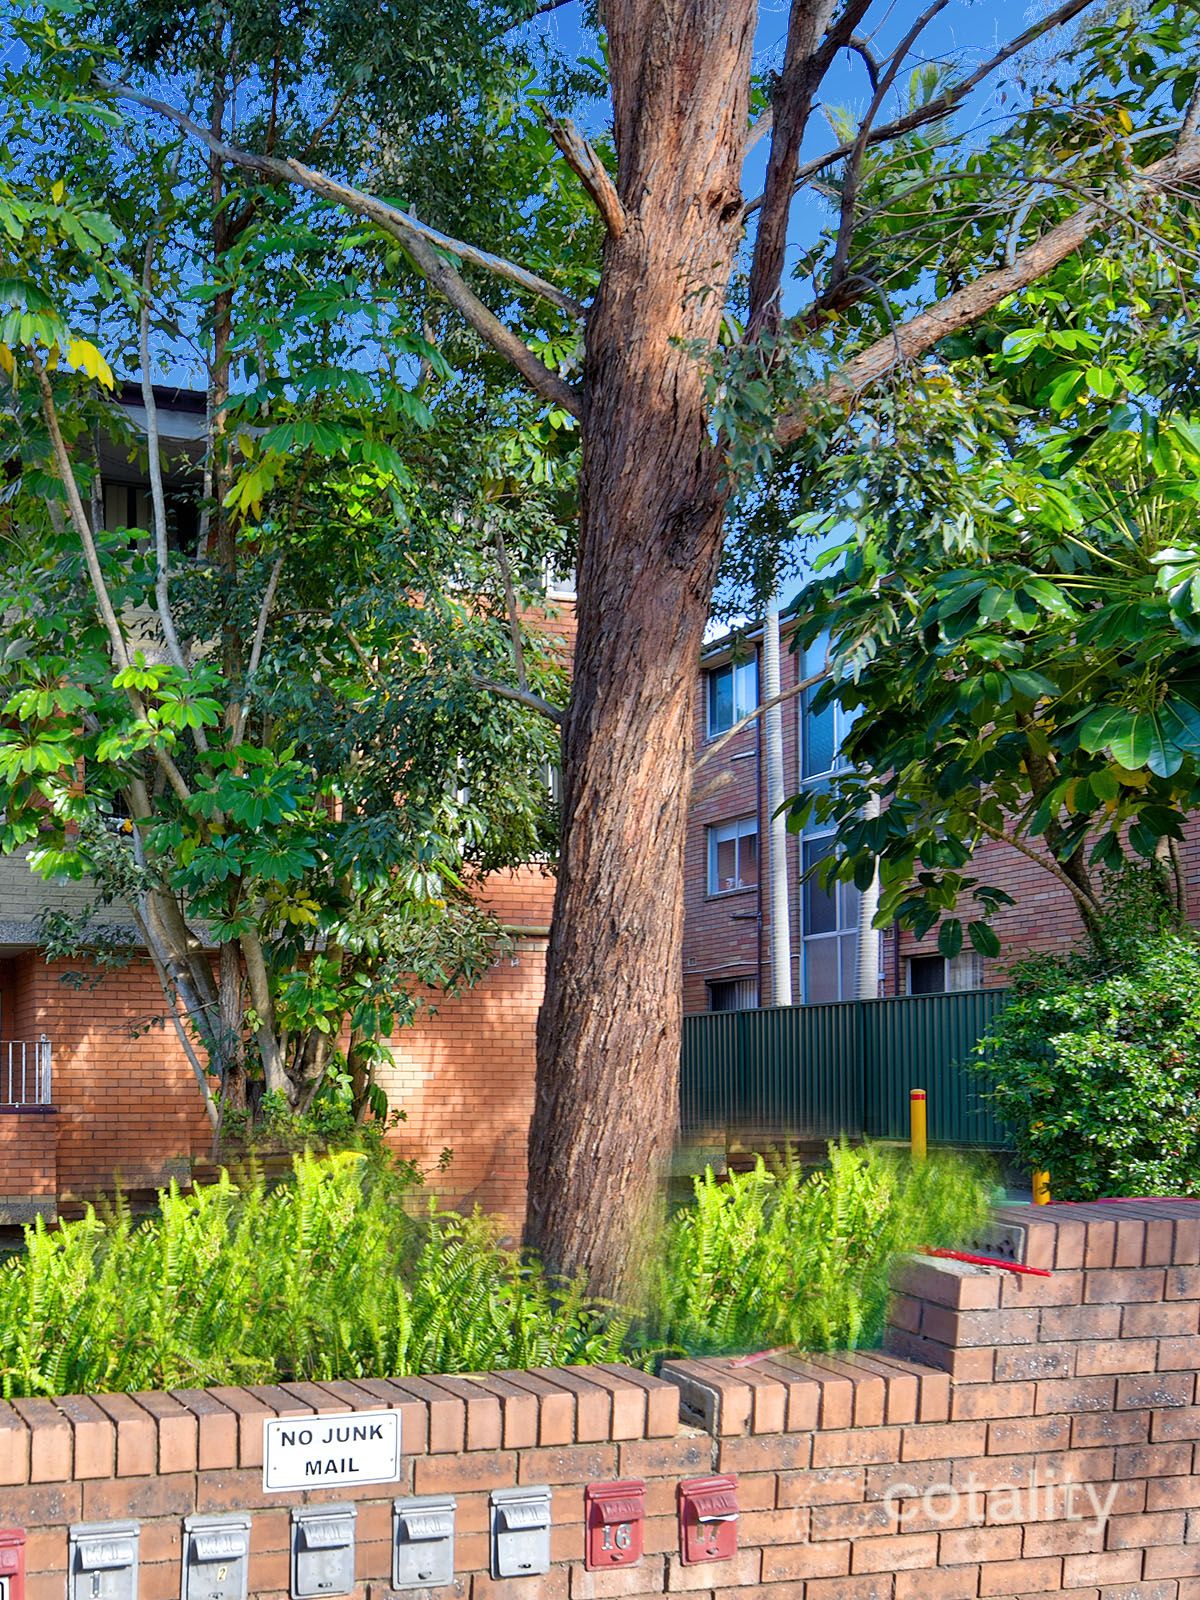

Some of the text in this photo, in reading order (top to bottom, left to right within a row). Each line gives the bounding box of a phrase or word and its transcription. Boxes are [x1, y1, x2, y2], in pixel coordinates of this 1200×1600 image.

[281, 1424, 383, 1447] NO JUNK
[305, 1457, 359, 1476] MAIL
[601, 1523, 632, 1551] 16
